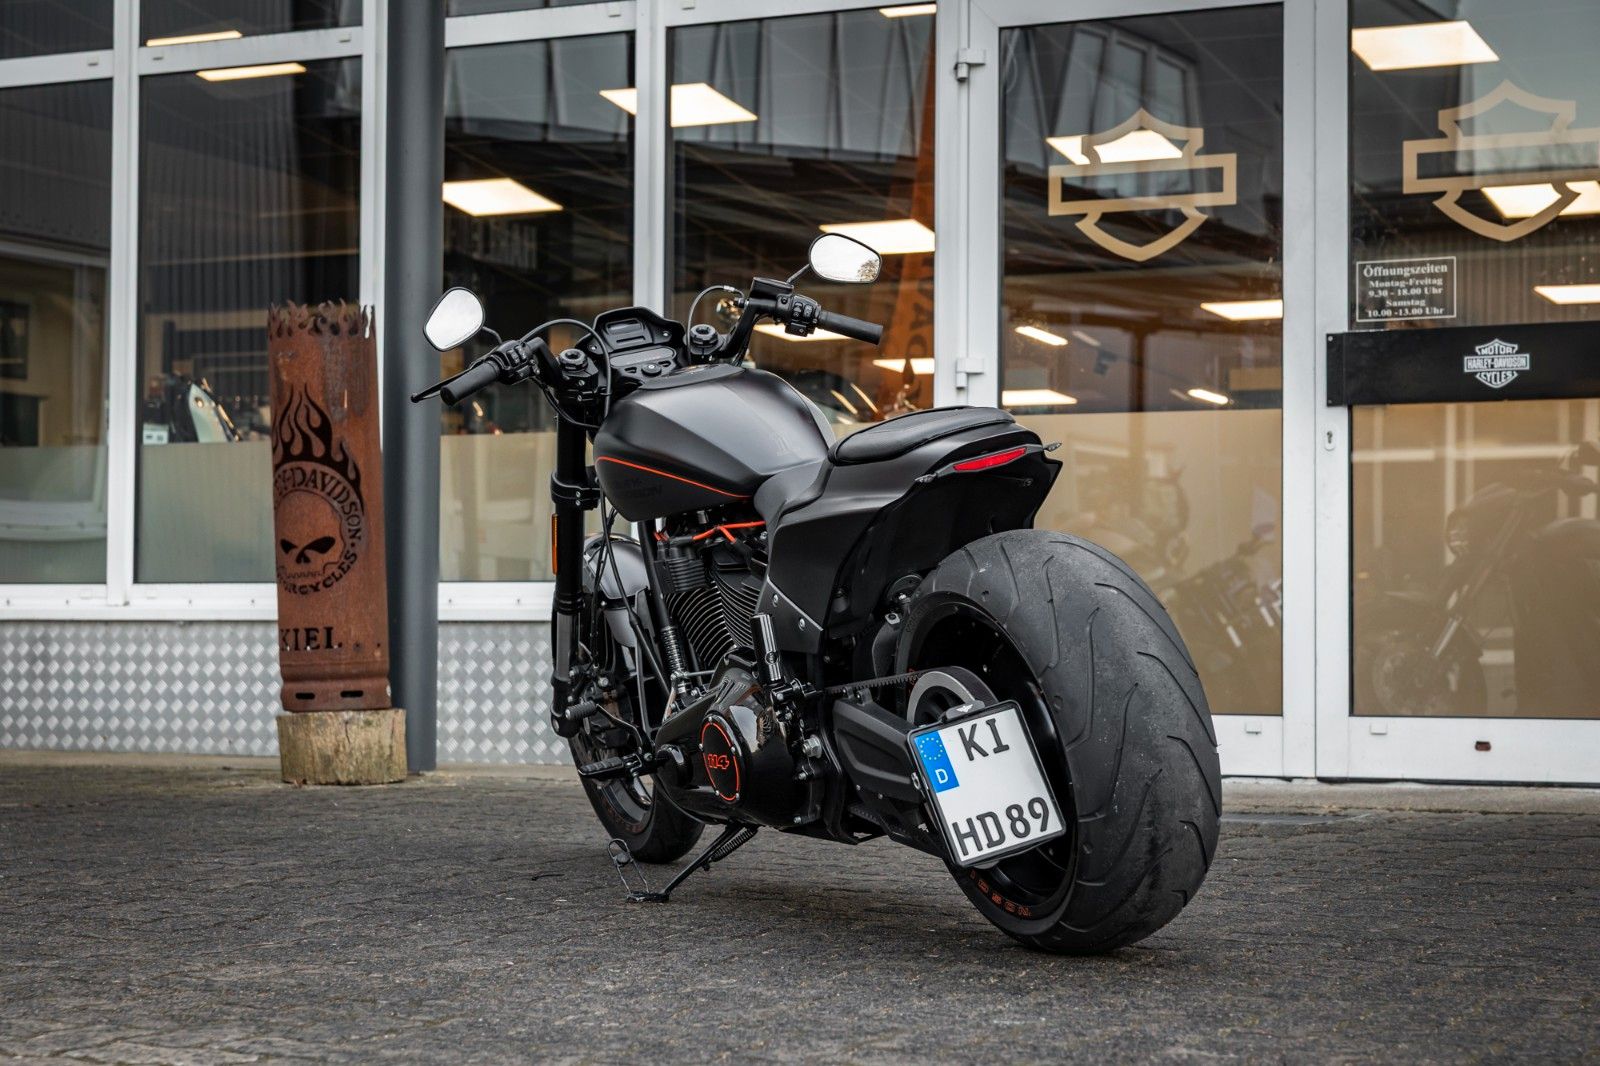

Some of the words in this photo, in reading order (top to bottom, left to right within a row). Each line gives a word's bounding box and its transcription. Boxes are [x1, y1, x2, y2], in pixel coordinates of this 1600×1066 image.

[1363, 264, 1448, 277] Öffnungszeiten
[1369, 278, 1443, 288] Montag-Freitag
[1424, 286, 1443, 295] Uhr
[1385, 298, 1426, 308] Samstag
[1425, 306, 1444, 315] Uhr
[1481, 343, 1513, 355] MOTOR
[1467, 357, 1527, 369] HARLEY-DAVIDSON
[1480, 371, 1513, 385] CYCLES
[957, 717, 1010, 762] KI
[935, 768, 949, 784] D
